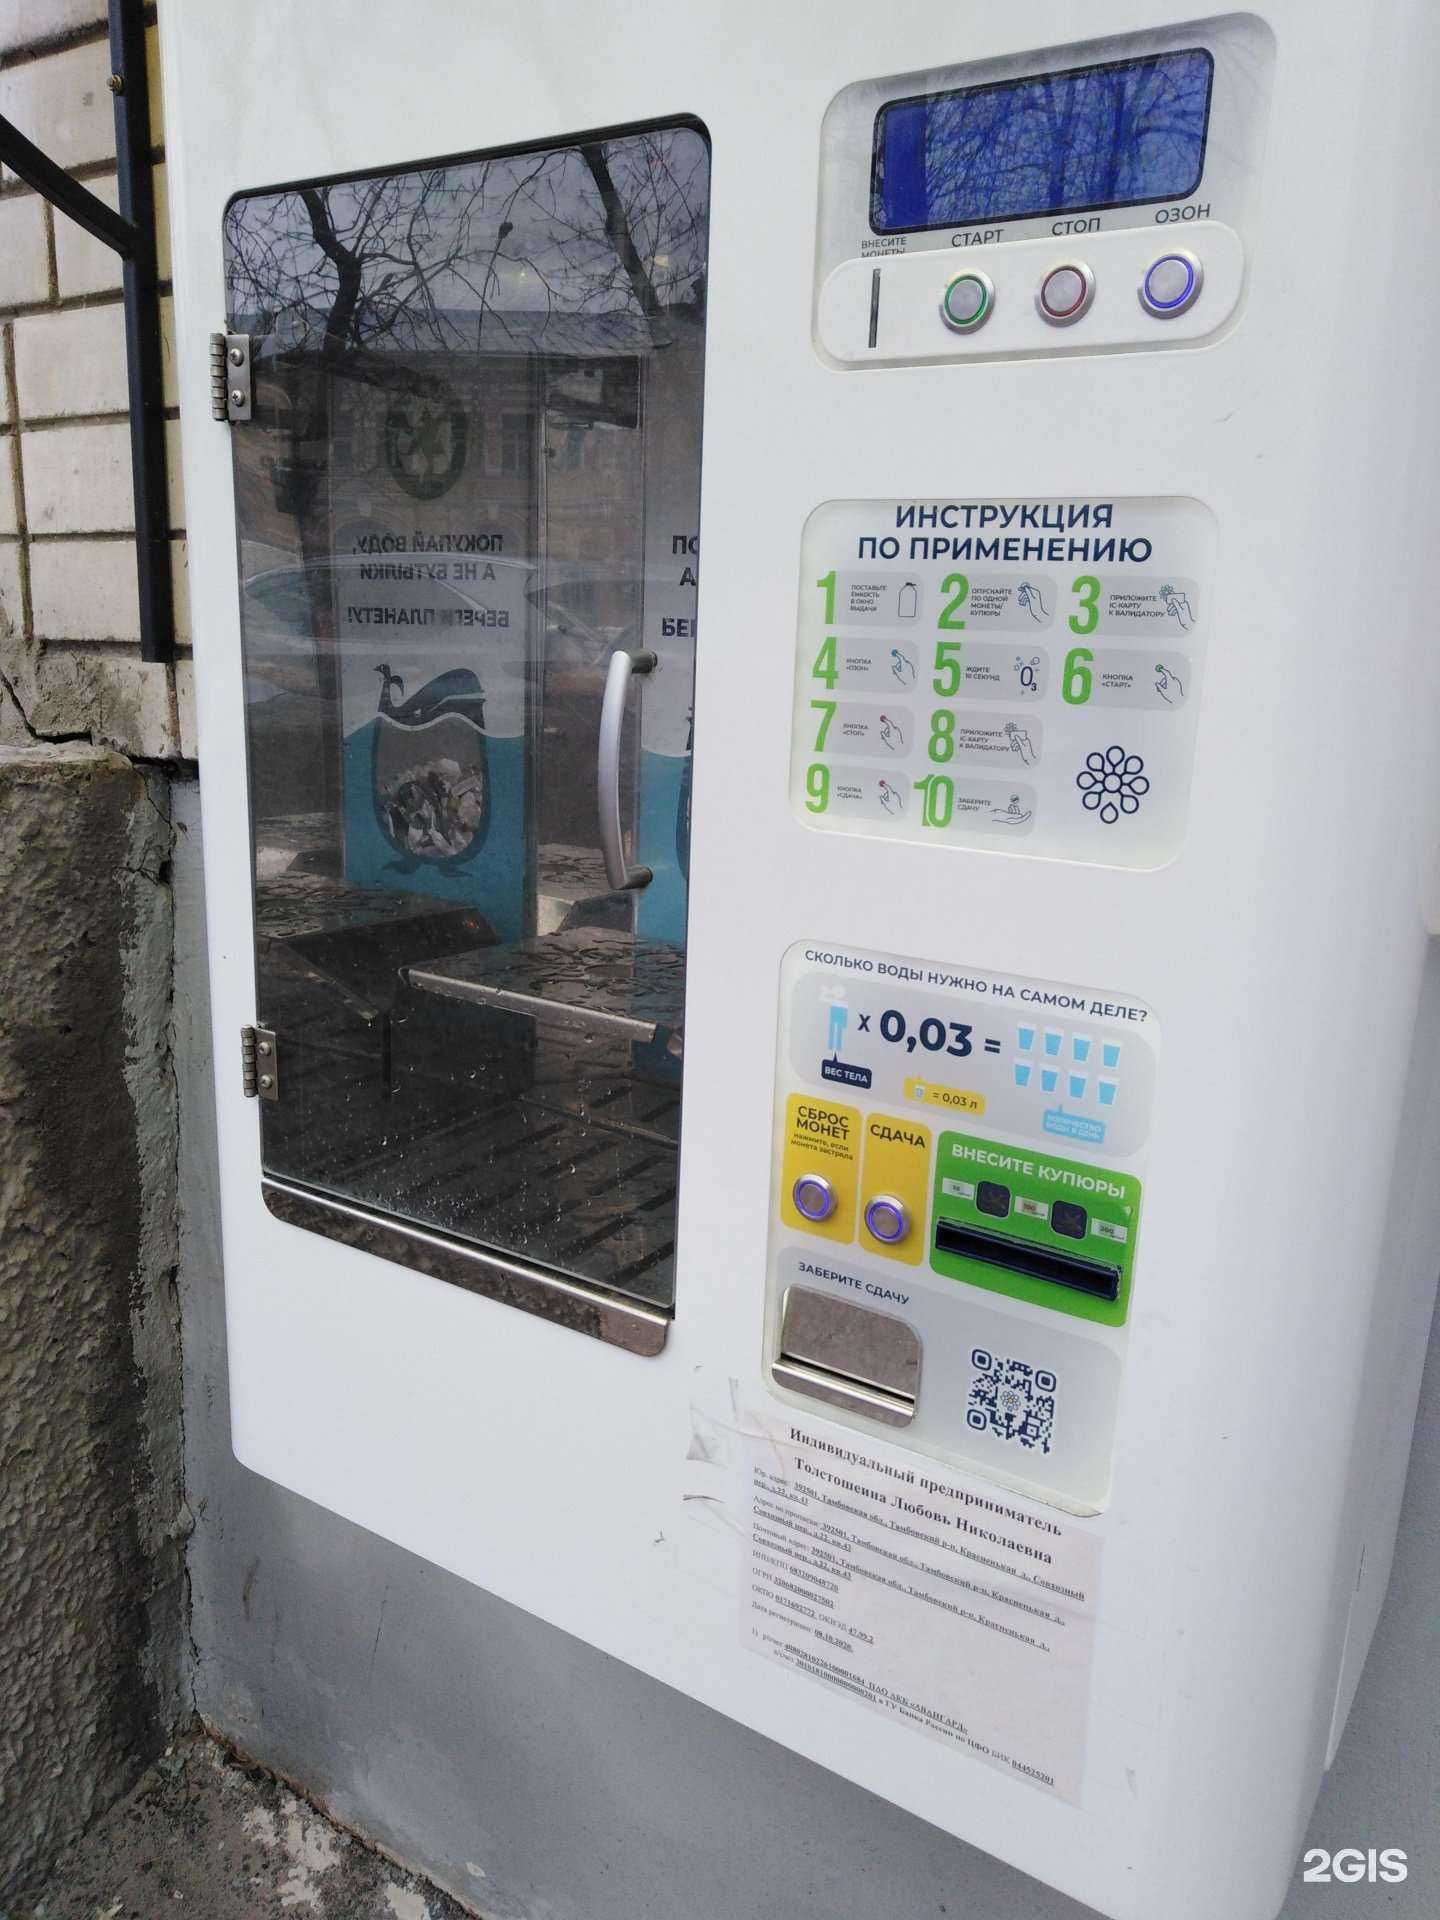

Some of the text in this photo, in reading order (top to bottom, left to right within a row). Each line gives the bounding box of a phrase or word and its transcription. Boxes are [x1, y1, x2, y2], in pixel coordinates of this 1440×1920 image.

[951, 229, 1004, 248] СТАРТ
[1052, 217, 1101, 236] СТОП
[1155, 203, 1211, 224] ОЗОН
[861, 236, 907, 249] ВНЕСИТЕ
[895, 503, 1114, 532] ИНСТРУКЦИЯ
[858, 536, 1153, 563] ПО ПРИМЕНЕНИЮ
[817, 571, 837, 624] 1
[937, 573, 969, 629] 2
[1068, 575, 1101, 635] 3
[812, 636, 839, 690] 4
[933, 641, 961, 697] 5
[1062, 647, 1094, 705] 6
[810, 699, 837, 752] 7
[928, 708, 955, 763] 8
[805, 763, 830, 814] 9
[913, 774, 954, 828] 10
[805, 949, 1148, 1022] СКОЛЬКО ВОДЫ НУЖНО НА САМОМ ДЕЛЕ?
[880, 1009, 973, 1057] 0,03
[824, 1065, 868, 1083] ВЕС ТЕЛА
[942, 1092, 967, 1106] 0,03
[796, 1117, 850, 1140] МОНЕТ
[798, 1105, 849, 1128] СБРОС
[870, 1124, 926, 1148] СДАЧА
[952, 1144, 1126, 1199] ВНЕСИТЕ КУПЮРЫ
[798, 1261, 910, 1305] ЗАБЕРИТЕ СДАЧУ
[790, 1427, 1062, 1536] Индивидуальный предприниматель
[890, 1496, 952, 1526] Любовь
[956, 1517, 1052, 1564] Николаевна
